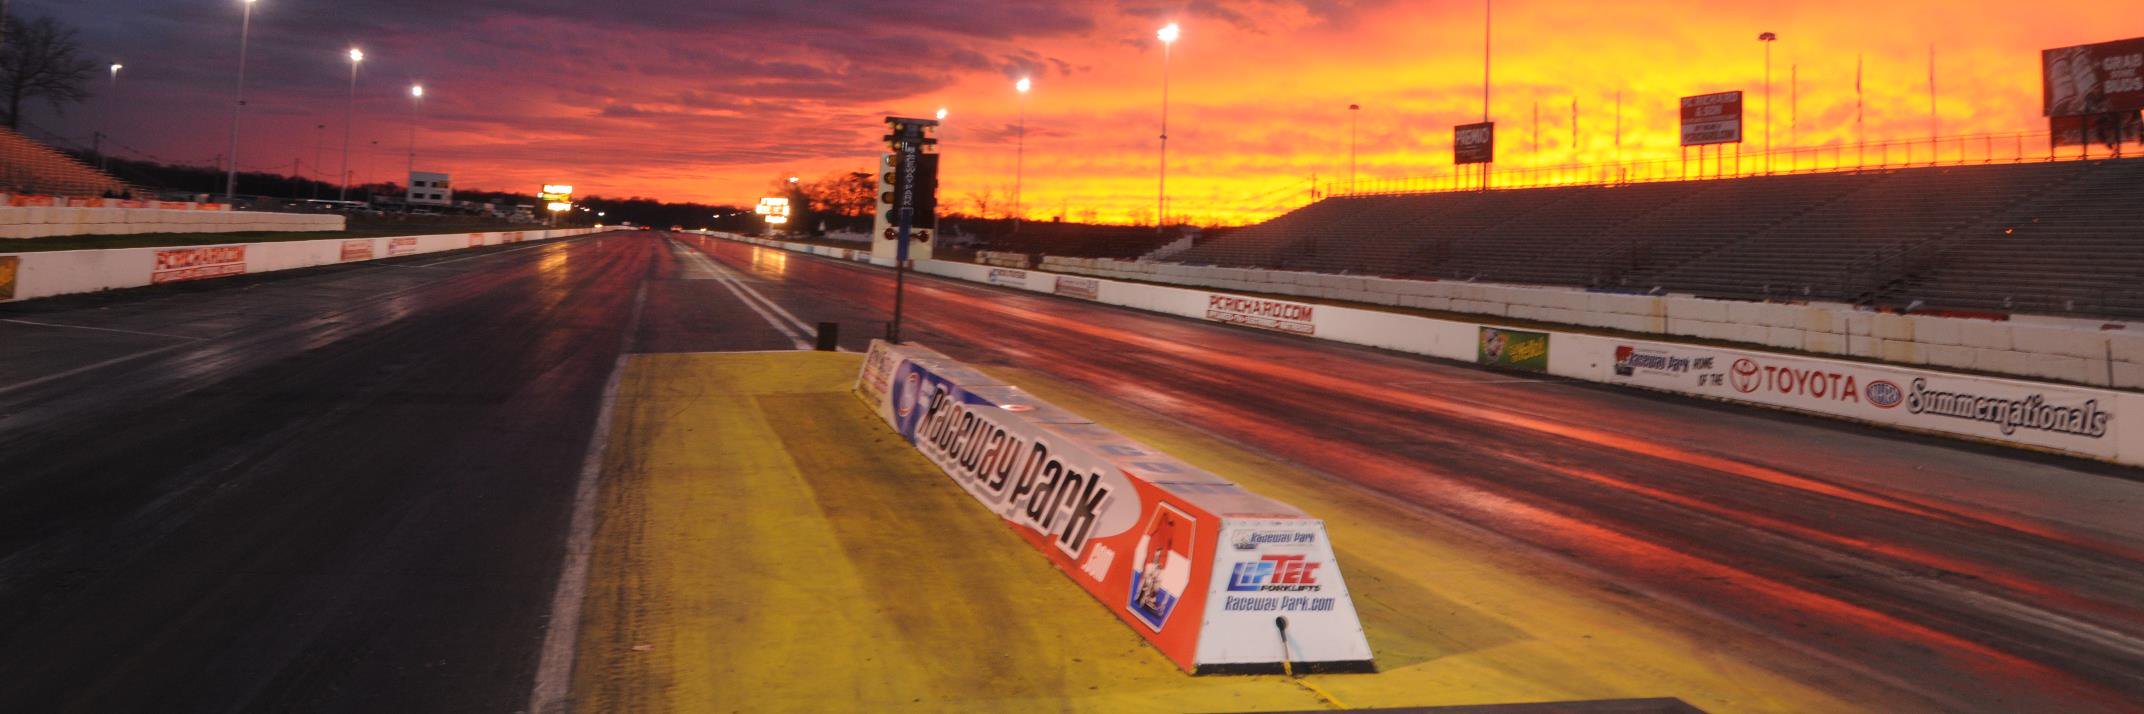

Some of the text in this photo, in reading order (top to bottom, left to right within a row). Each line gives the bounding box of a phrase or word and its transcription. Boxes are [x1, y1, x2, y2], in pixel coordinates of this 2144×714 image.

[2103, 54, 2142, 70] GRAB
[2104, 77, 2144, 94] BUDS
[1209, 295, 1313, 321] PCRICHARD.COM
[1693, 357, 1714, 370] HOME
[1698, 373, 1724, 387] OF THE
[1764, 366, 1859, 402] TOYOTA
[1908, 377, 2108, 438] Summernationals
[918, 384, 1108, 552] Raceway Park
[1250, 532, 1314, 543] Raceway Park
[1225, 596, 1335, 611] Raceway Park.com
